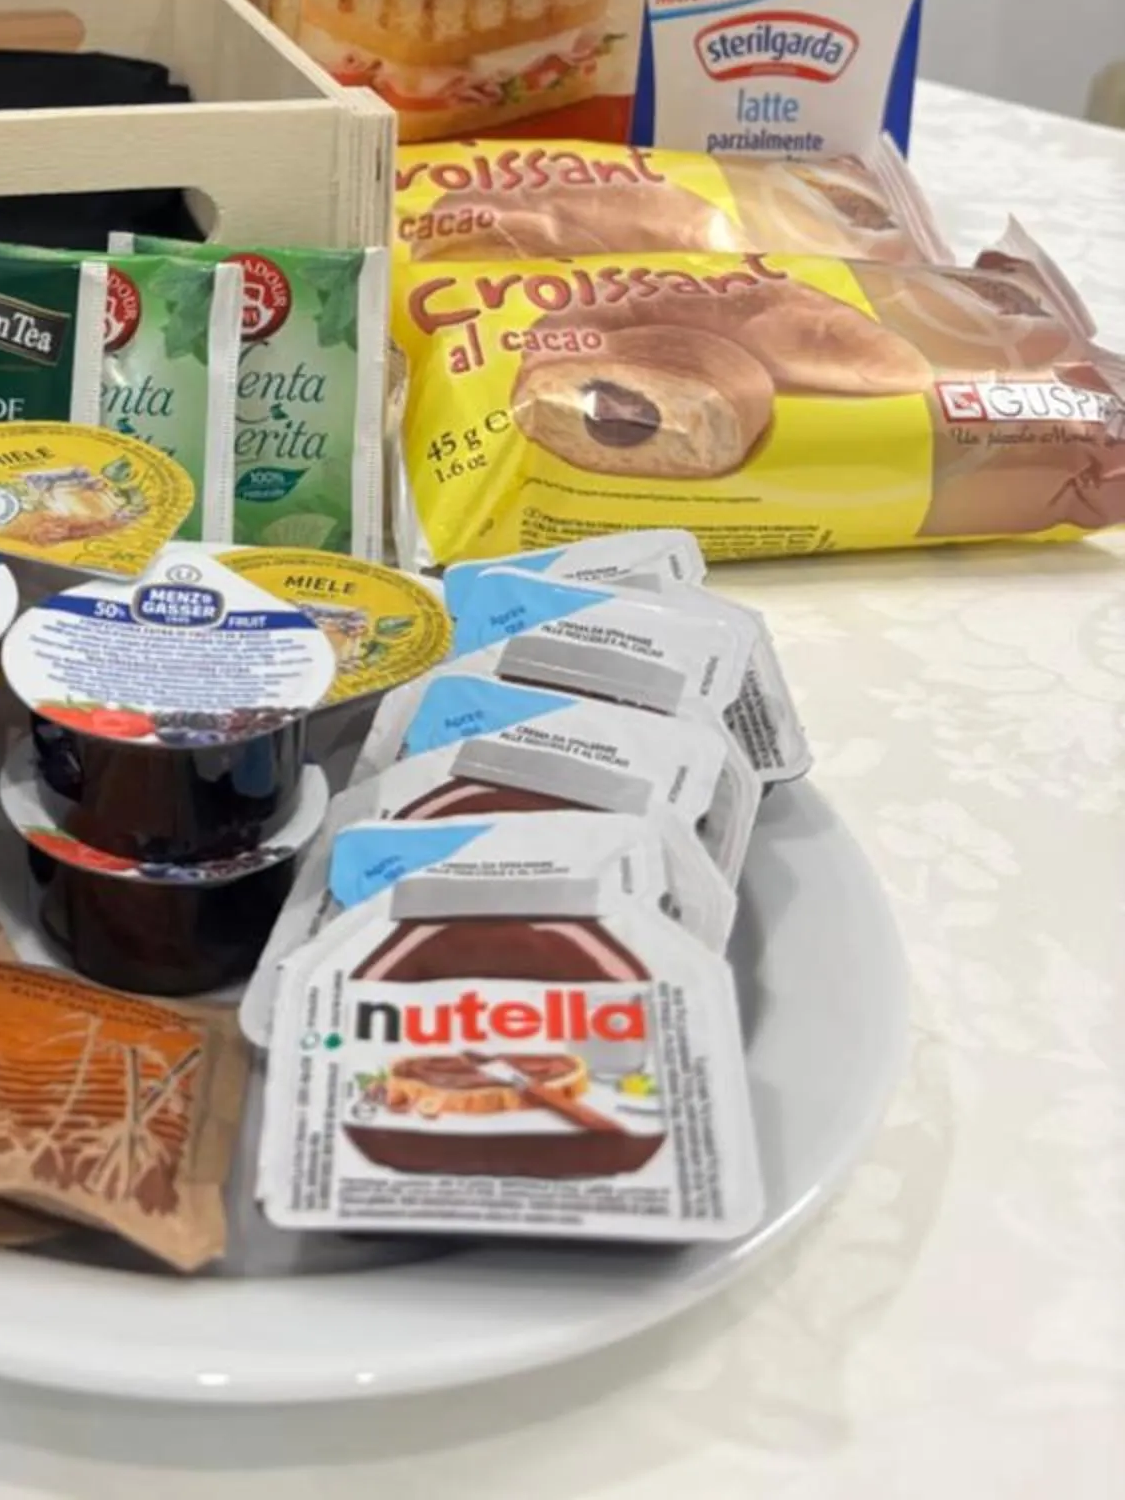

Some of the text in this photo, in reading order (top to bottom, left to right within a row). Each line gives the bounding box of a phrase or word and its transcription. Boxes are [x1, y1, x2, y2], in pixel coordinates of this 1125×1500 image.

[706, 24, 844, 63] sterilgarda
[736, 88, 800, 123] latte
[706, 132, 824, 154] parzialmente
[395, 140, 665, 192] roissant
[398, 207, 495, 240] cacao
[407, 252, 788, 336] Croissant
[12, 308, 52, 352] Tea
[449, 322, 603, 375] al cacao
[238, 360, 327, 404] enta
[235, 419, 329, 461] erita
[426, 432, 456, 466] 45
[463, 425, 483, 453] g
[434, 458, 465, 484] 1.6
[283, 573, 359, 597] MIELE
[141, 600, 217, 618] GASSER
[227, 614, 268, 630] FRUIT
[355, 989, 649, 1046] nutella
